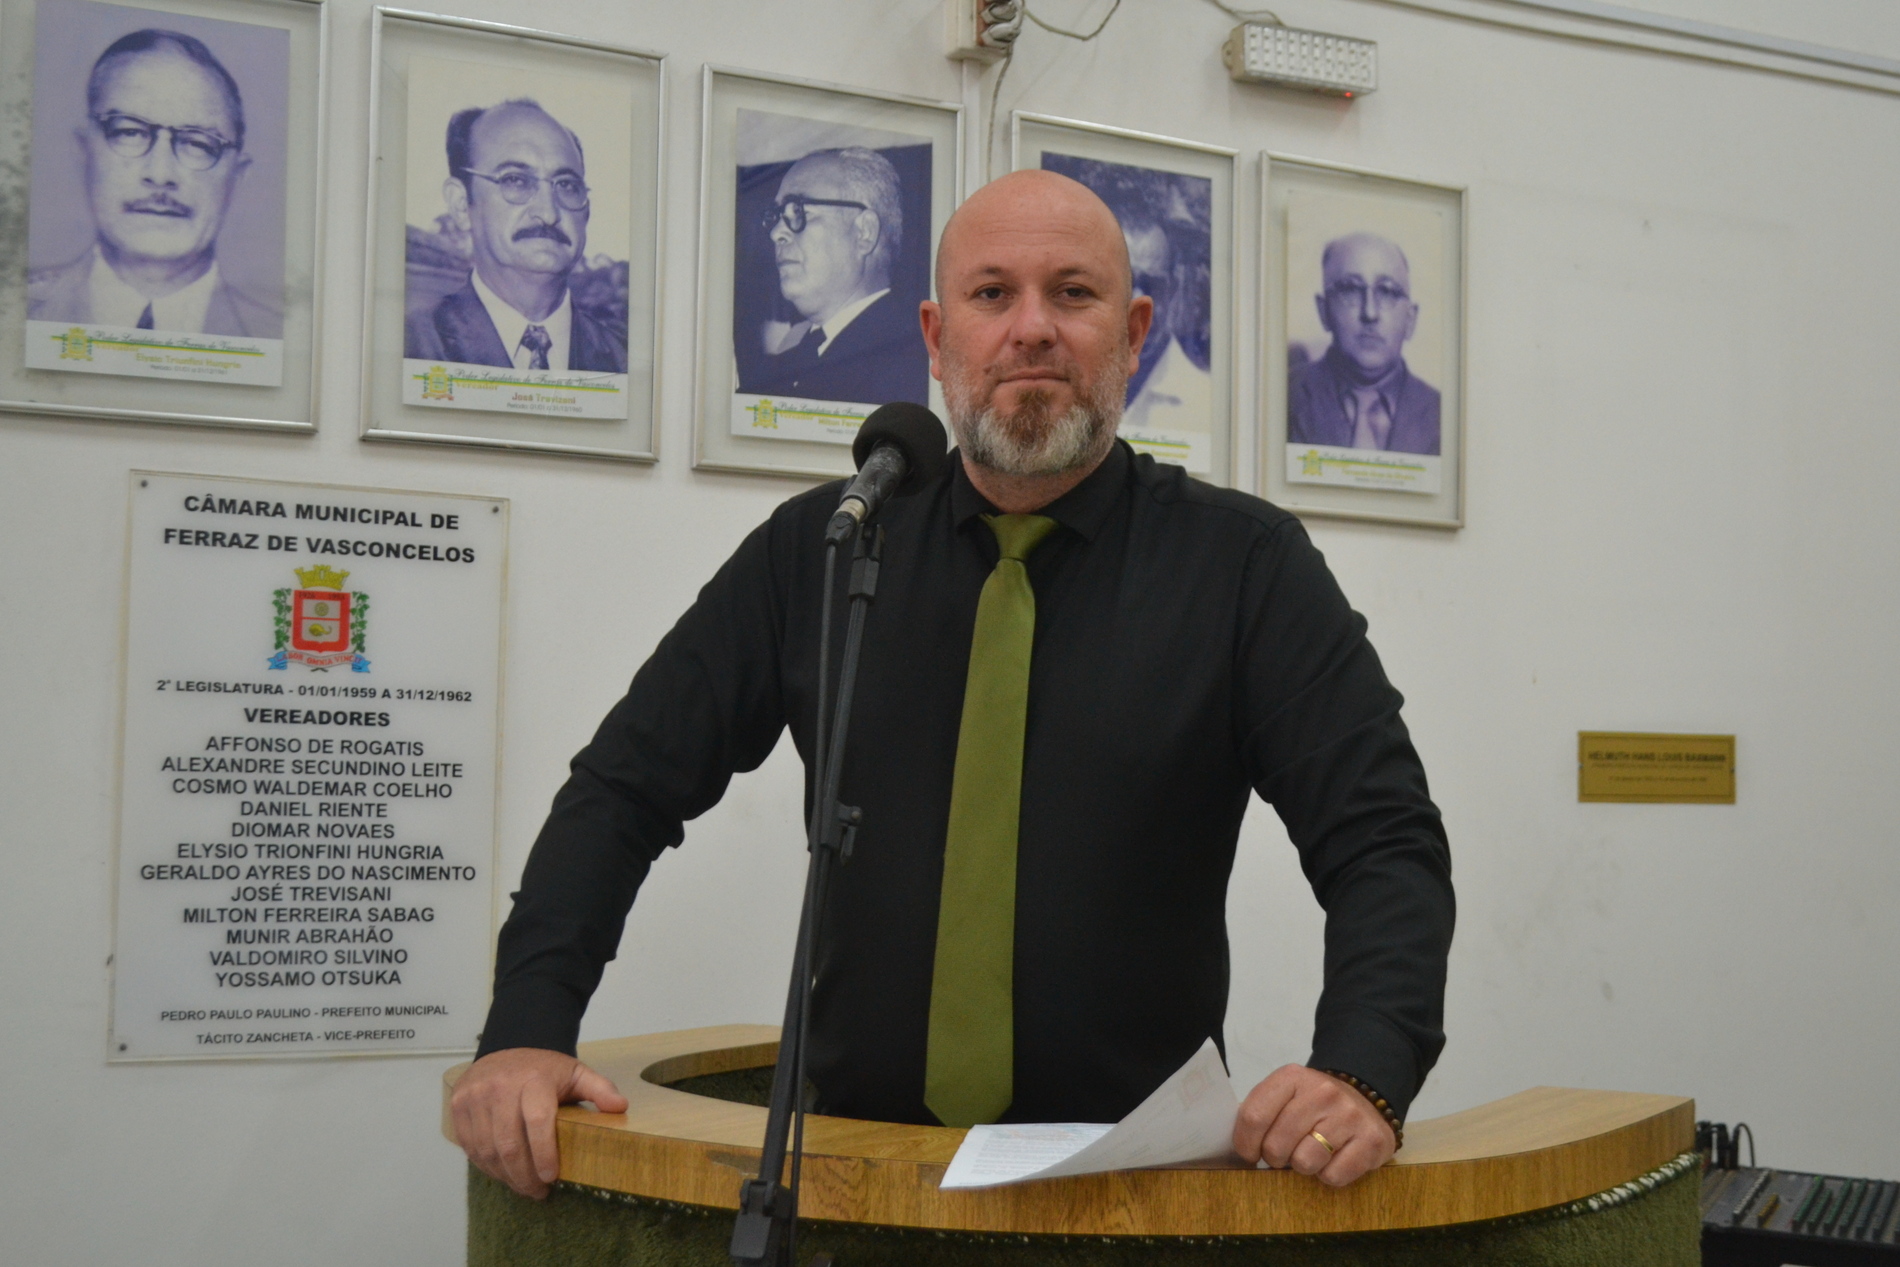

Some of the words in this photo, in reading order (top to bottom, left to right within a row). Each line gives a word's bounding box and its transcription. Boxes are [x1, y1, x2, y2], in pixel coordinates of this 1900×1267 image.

[184, 494, 287, 518] CÂMARA
[295, 504, 422, 527] MUNICIPAL
[430, 513, 459, 530] DE
[164, 528, 259, 549] FERRAZ
[267, 535, 298, 552] DE
[306, 537, 475, 563] VASCONCELOS
[175, 680, 285, 696] LEGISLATURA
[297, 684, 378, 699] 01/01/1959
[380, 688, 392, 700] A
[395, 688, 473, 703] 31/12/1962
[244, 708, 390, 727] VEREADORES
[205, 736, 301, 753] AFFONSO
[308, 739, 333, 754] DE
[341, 740, 423, 756] ROGATIS
[161, 757, 284, 774] ALEXANDRE
[292, 759, 405, 776] SECUNDINO
[412, 763, 462, 778] LEITE
[173, 778, 247, 794] COSMO
[254, 780, 366, 796] WALDEMAR
[373, 782, 452, 798] COELHO
[241, 801, 312, 816] DANIEL
[319, 802, 387, 818] RIENTE
[232, 822, 310, 837] DIOMAR
[317, 823, 394, 839] NOVAES
[178, 843, 248, 859] ELYSIO
[254, 844, 350, 859] TRIONFINI
[358, 845, 444, 860] HUNGRIA
[140, 865, 240, 880] GERALDO
[245, 865, 310, 881] AYRES
[318, 865, 345, 880] DO
[352, 866, 476, 881] NASCIMENTO
[231, 883, 283, 901] JOSÉ
[290, 886, 391, 901] TREVISANI
[184, 908, 257, 923] MILTON
[264, 908, 362, 922] FERREIRA
[368, 907, 434, 922] SABAG
[227, 929, 290, 944] MUNIR
[296, 926, 393, 943] ABRAHÃO
[210, 950, 328, 966] VALDOMIRO
[334, 949, 408, 964] SILVINO
[216, 971, 315, 987] YOSSAMO
[322, 970, 401, 986] OTSUKA
[160, 1010, 207, 1022] PEDRO
[209, 1009, 253, 1020] PAULO
[256, 1007, 311, 1019] PAULINO
[321, 1006, 382, 1018] PREFEITO
[384, 1005, 449, 1017] MUNICIPAL
[196, 1032, 244, 1045] TÁCITO
[245, 1031, 314, 1044] ZANCHETA
[323, 1028, 416, 1041] VICE-PREFEITO
